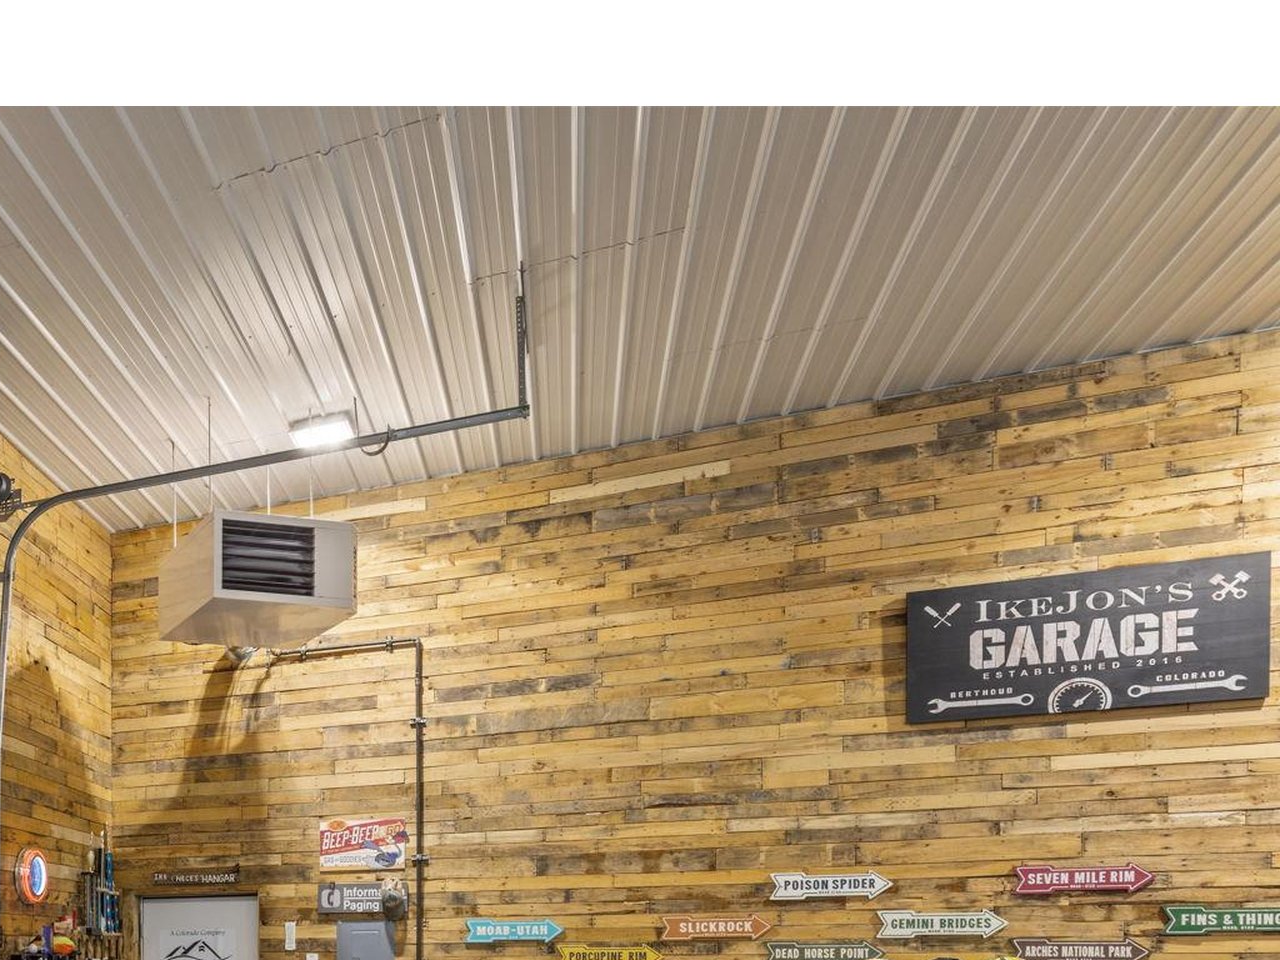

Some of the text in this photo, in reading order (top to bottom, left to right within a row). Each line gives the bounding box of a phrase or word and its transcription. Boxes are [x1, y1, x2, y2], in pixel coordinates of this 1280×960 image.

[974, 581, 1194, 624] IKEJON'S
[969, 607, 1200, 671] GARAGE
[982, 660, 1121, 680] ESTABLISHED
[1156, 669, 1226, 683] COLORADO
[1027, 870, 1135, 885] SEVEN MILE RIM
[784, 878, 876, 891] POISON SPIDER
[343, 900, 380, 912] Paging
[891, 917, 992, 929] GEMINI BRIDGES
[1181, 913, 1218, 926] FINS
[1223, 913, 1234, 925] &
[476, 925, 548, 936] MOAB-UTAH
[679, 921, 753, 933] SLICKROCK
[628, 951, 647, 960] RIM
[775, 947, 870, 959] DEAD HORSE POINT
[1025, 945, 1133, 957] ARCHES NATIONAL PARK
